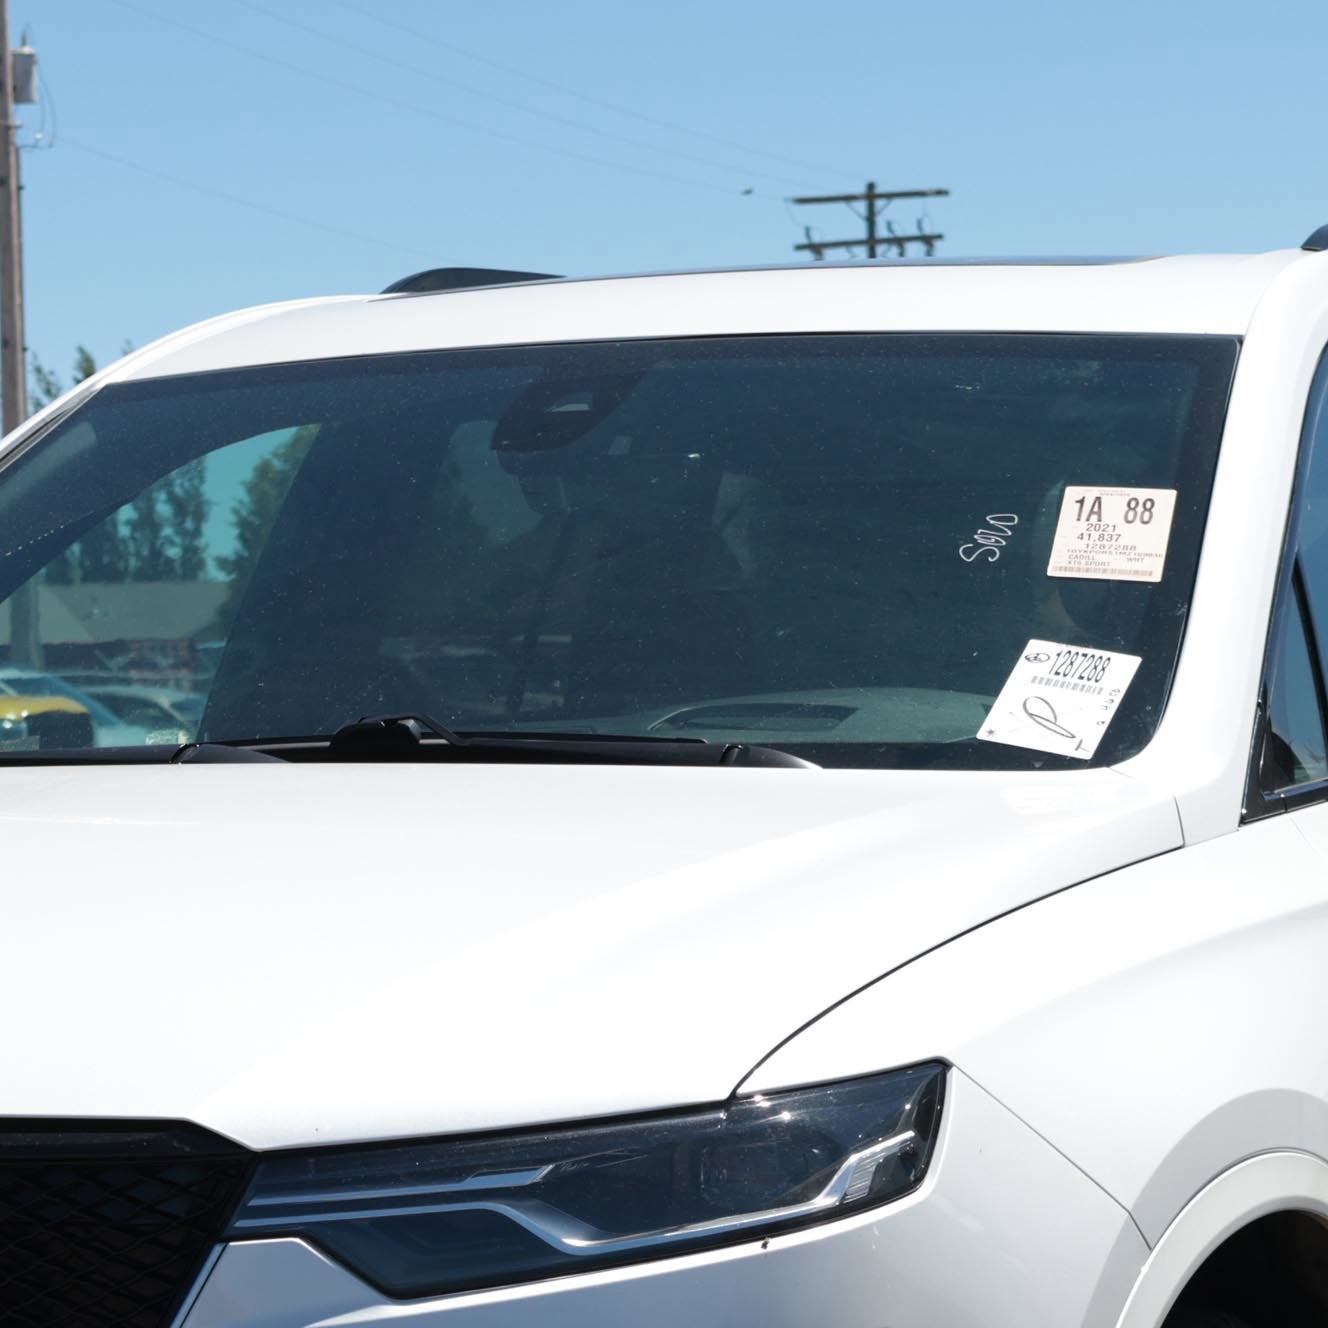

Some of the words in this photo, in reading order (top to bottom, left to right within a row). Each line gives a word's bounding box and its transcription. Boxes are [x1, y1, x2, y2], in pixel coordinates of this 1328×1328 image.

[1075, 496, 1102, 522] 1A
[1124, 497, 1156, 525] 88
[1086, 523, 1117, 533] 2021
[1086, 543, 1137, 551] 1287288
[1048, 650, 1111, 683] 1287288
